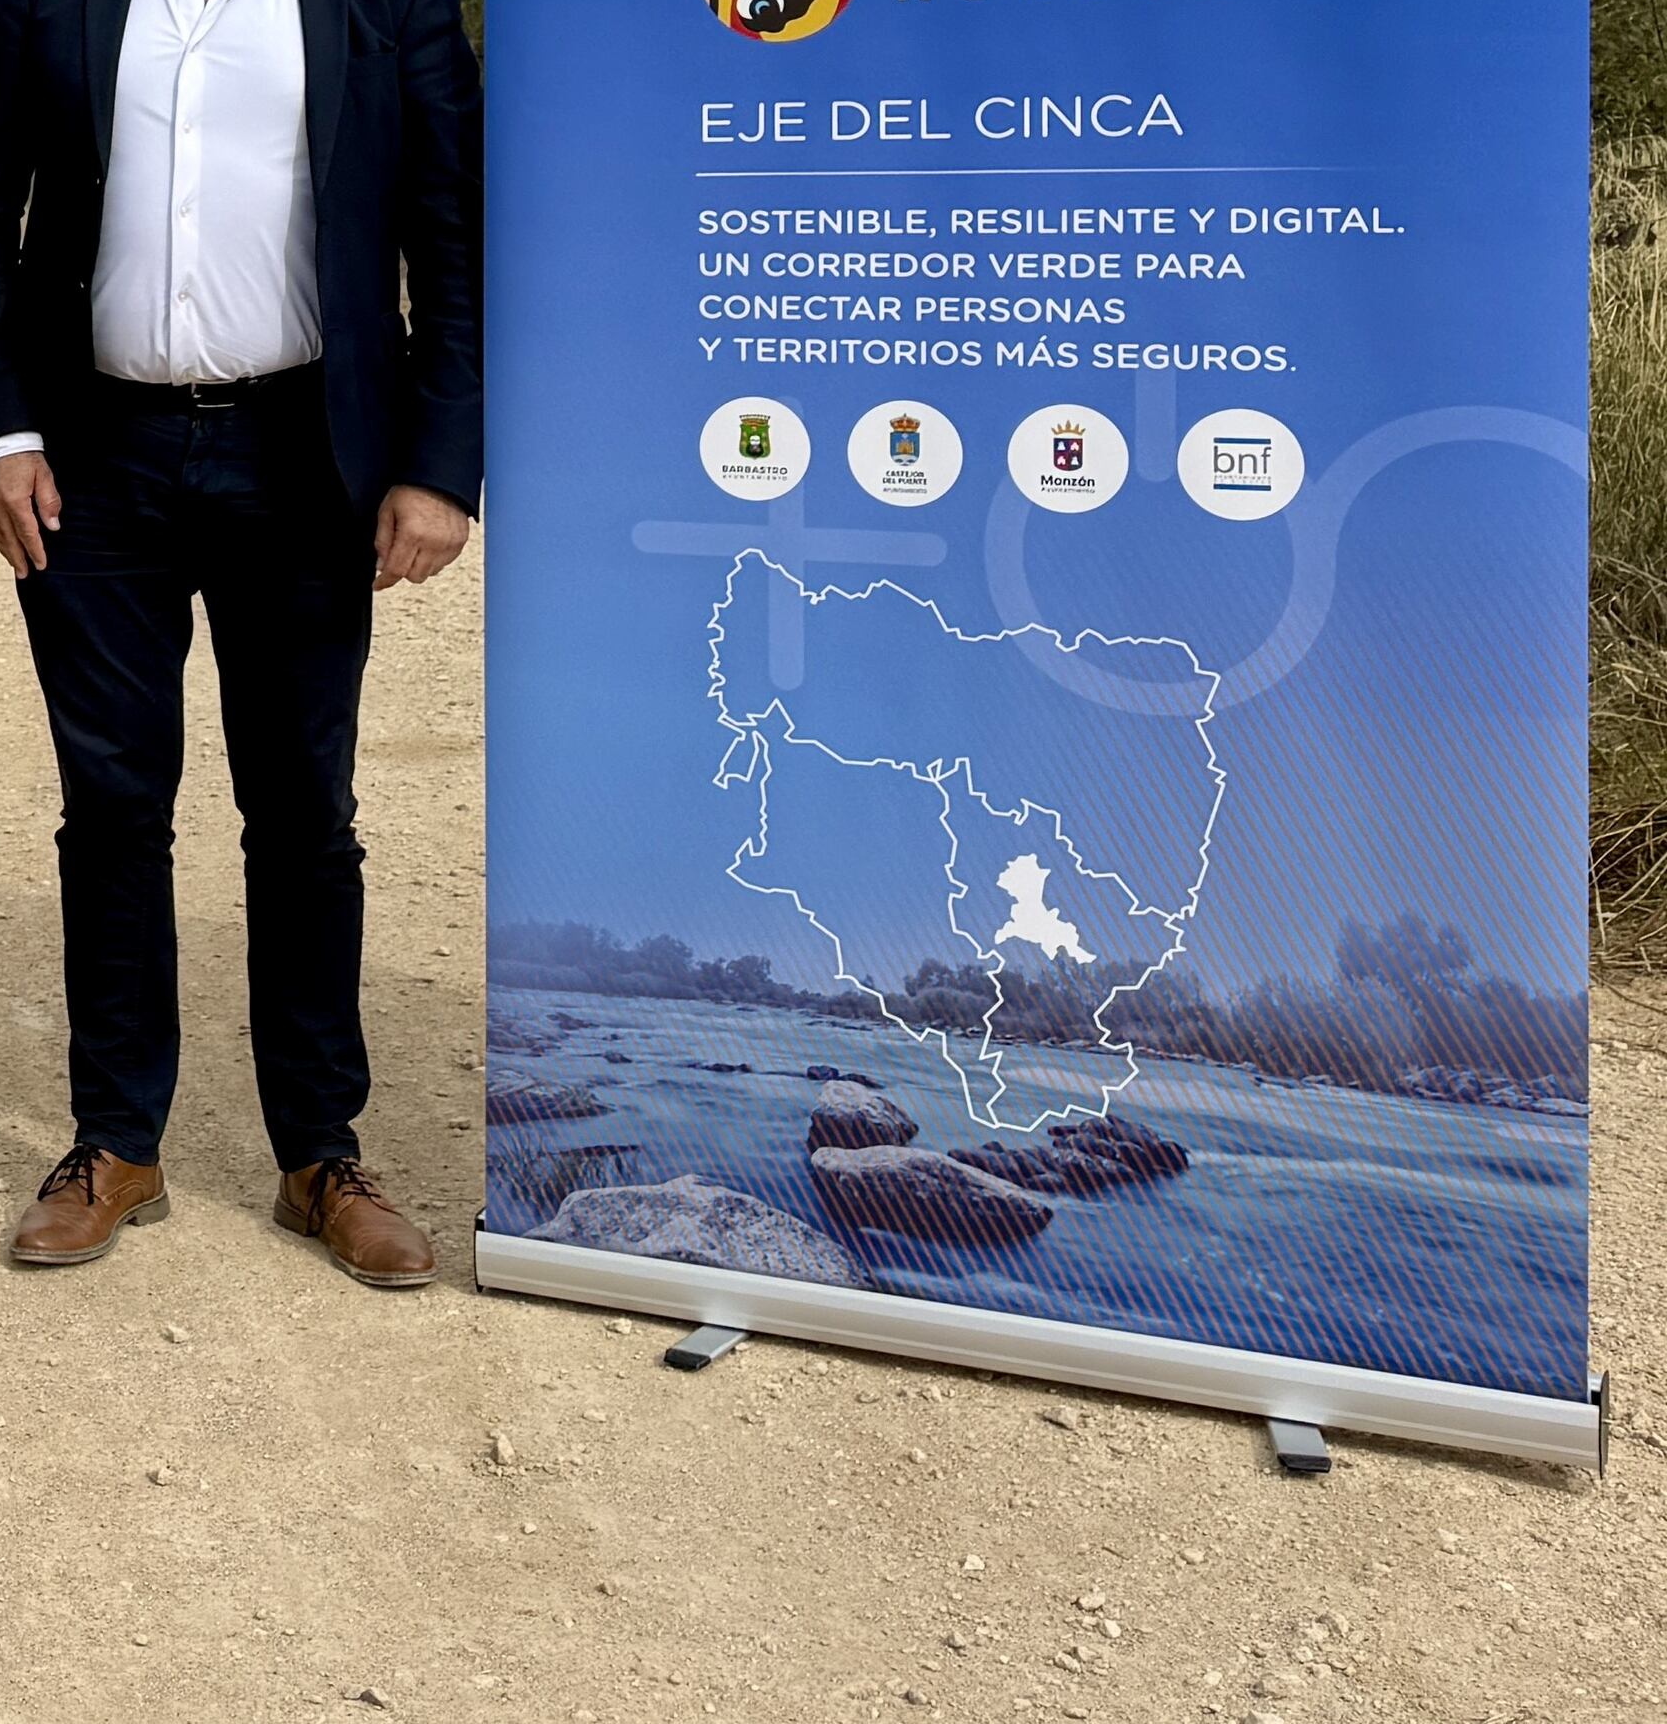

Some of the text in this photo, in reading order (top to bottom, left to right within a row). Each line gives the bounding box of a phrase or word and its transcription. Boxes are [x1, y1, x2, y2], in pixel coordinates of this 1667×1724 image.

[703, 94, 1183, 142] EJE DEL CINCA
[699, 208, 1404, 237] SOSTENIBLE, RESILIENTE Y DIGITAL.
[700, 253, 1244, 278] UN CORREDOR VERDE PARA
[700, 295, 1125, 323] CONECTAR PERSONAS
[699, 336, 1295, 371] Y TERRITORIOS MÁS SEGUROS.
[722, 465, 788, 475] BARBASTRO
[1213, 445, 1272, 475] bnf
[1040, 474, 1095, 487] Monzón
